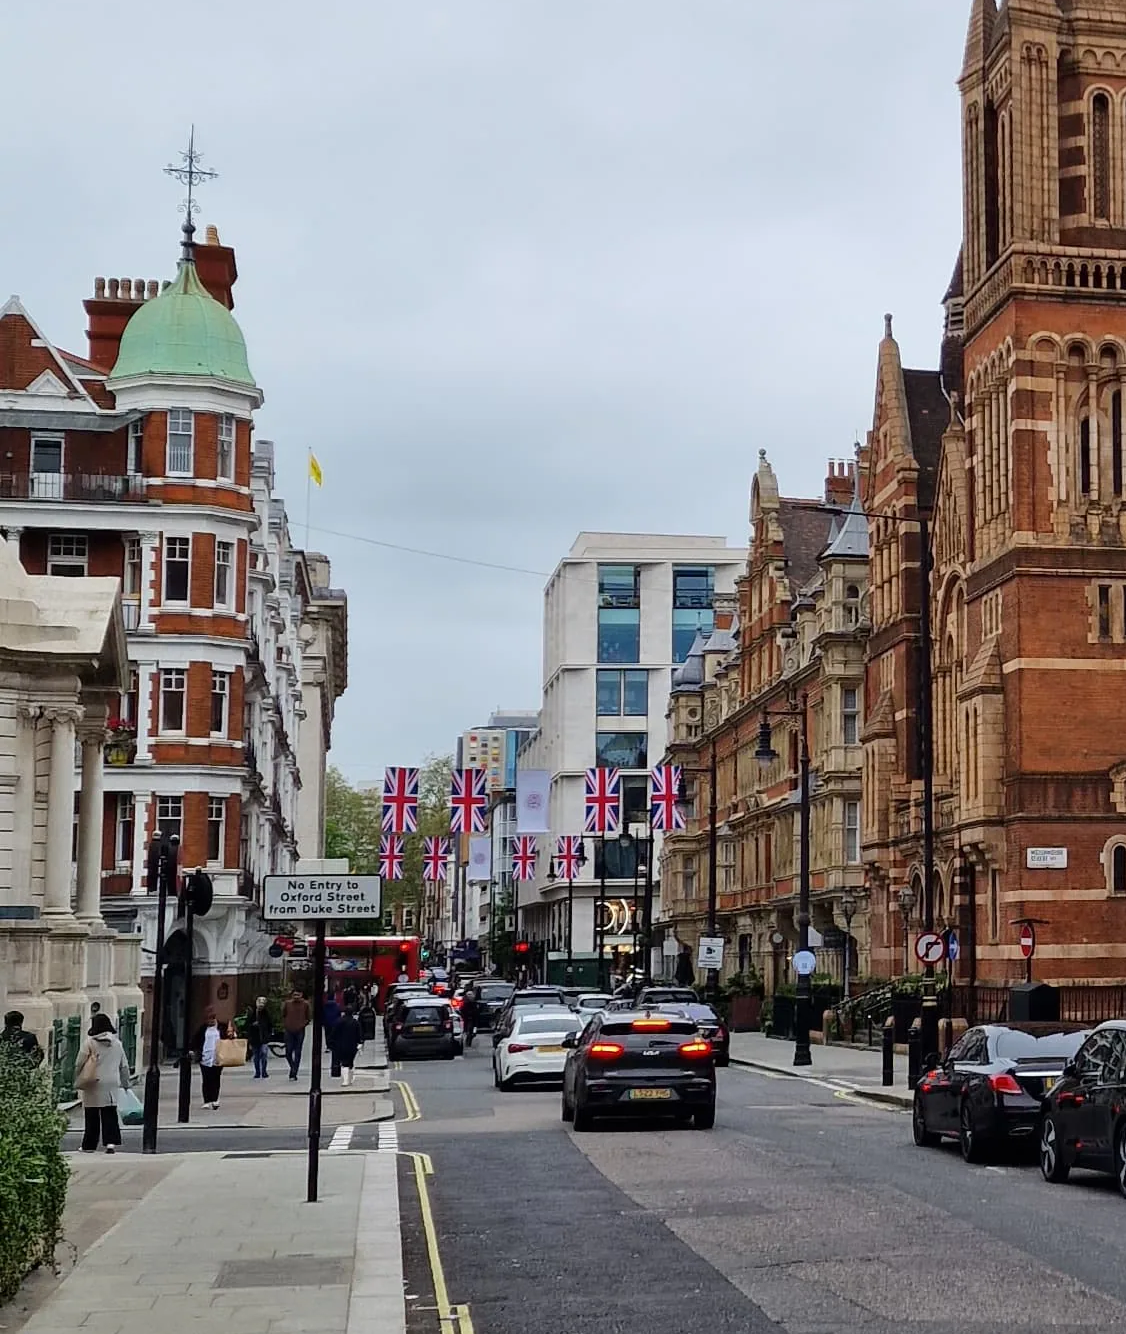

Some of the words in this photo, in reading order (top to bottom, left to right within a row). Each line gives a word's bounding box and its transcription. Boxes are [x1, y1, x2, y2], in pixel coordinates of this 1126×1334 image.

[287, 880, 305, 890] No
[309, 880, 342, 891] Entry
[346, 880, 359, 890] to
[280, 892, 322, 902] Oxford
[327, 892, 365, 902] Street
[269, 904, 297, 914] from
[302, 904, 333, 914] Duke
[337, 904, 376, 914] Street
